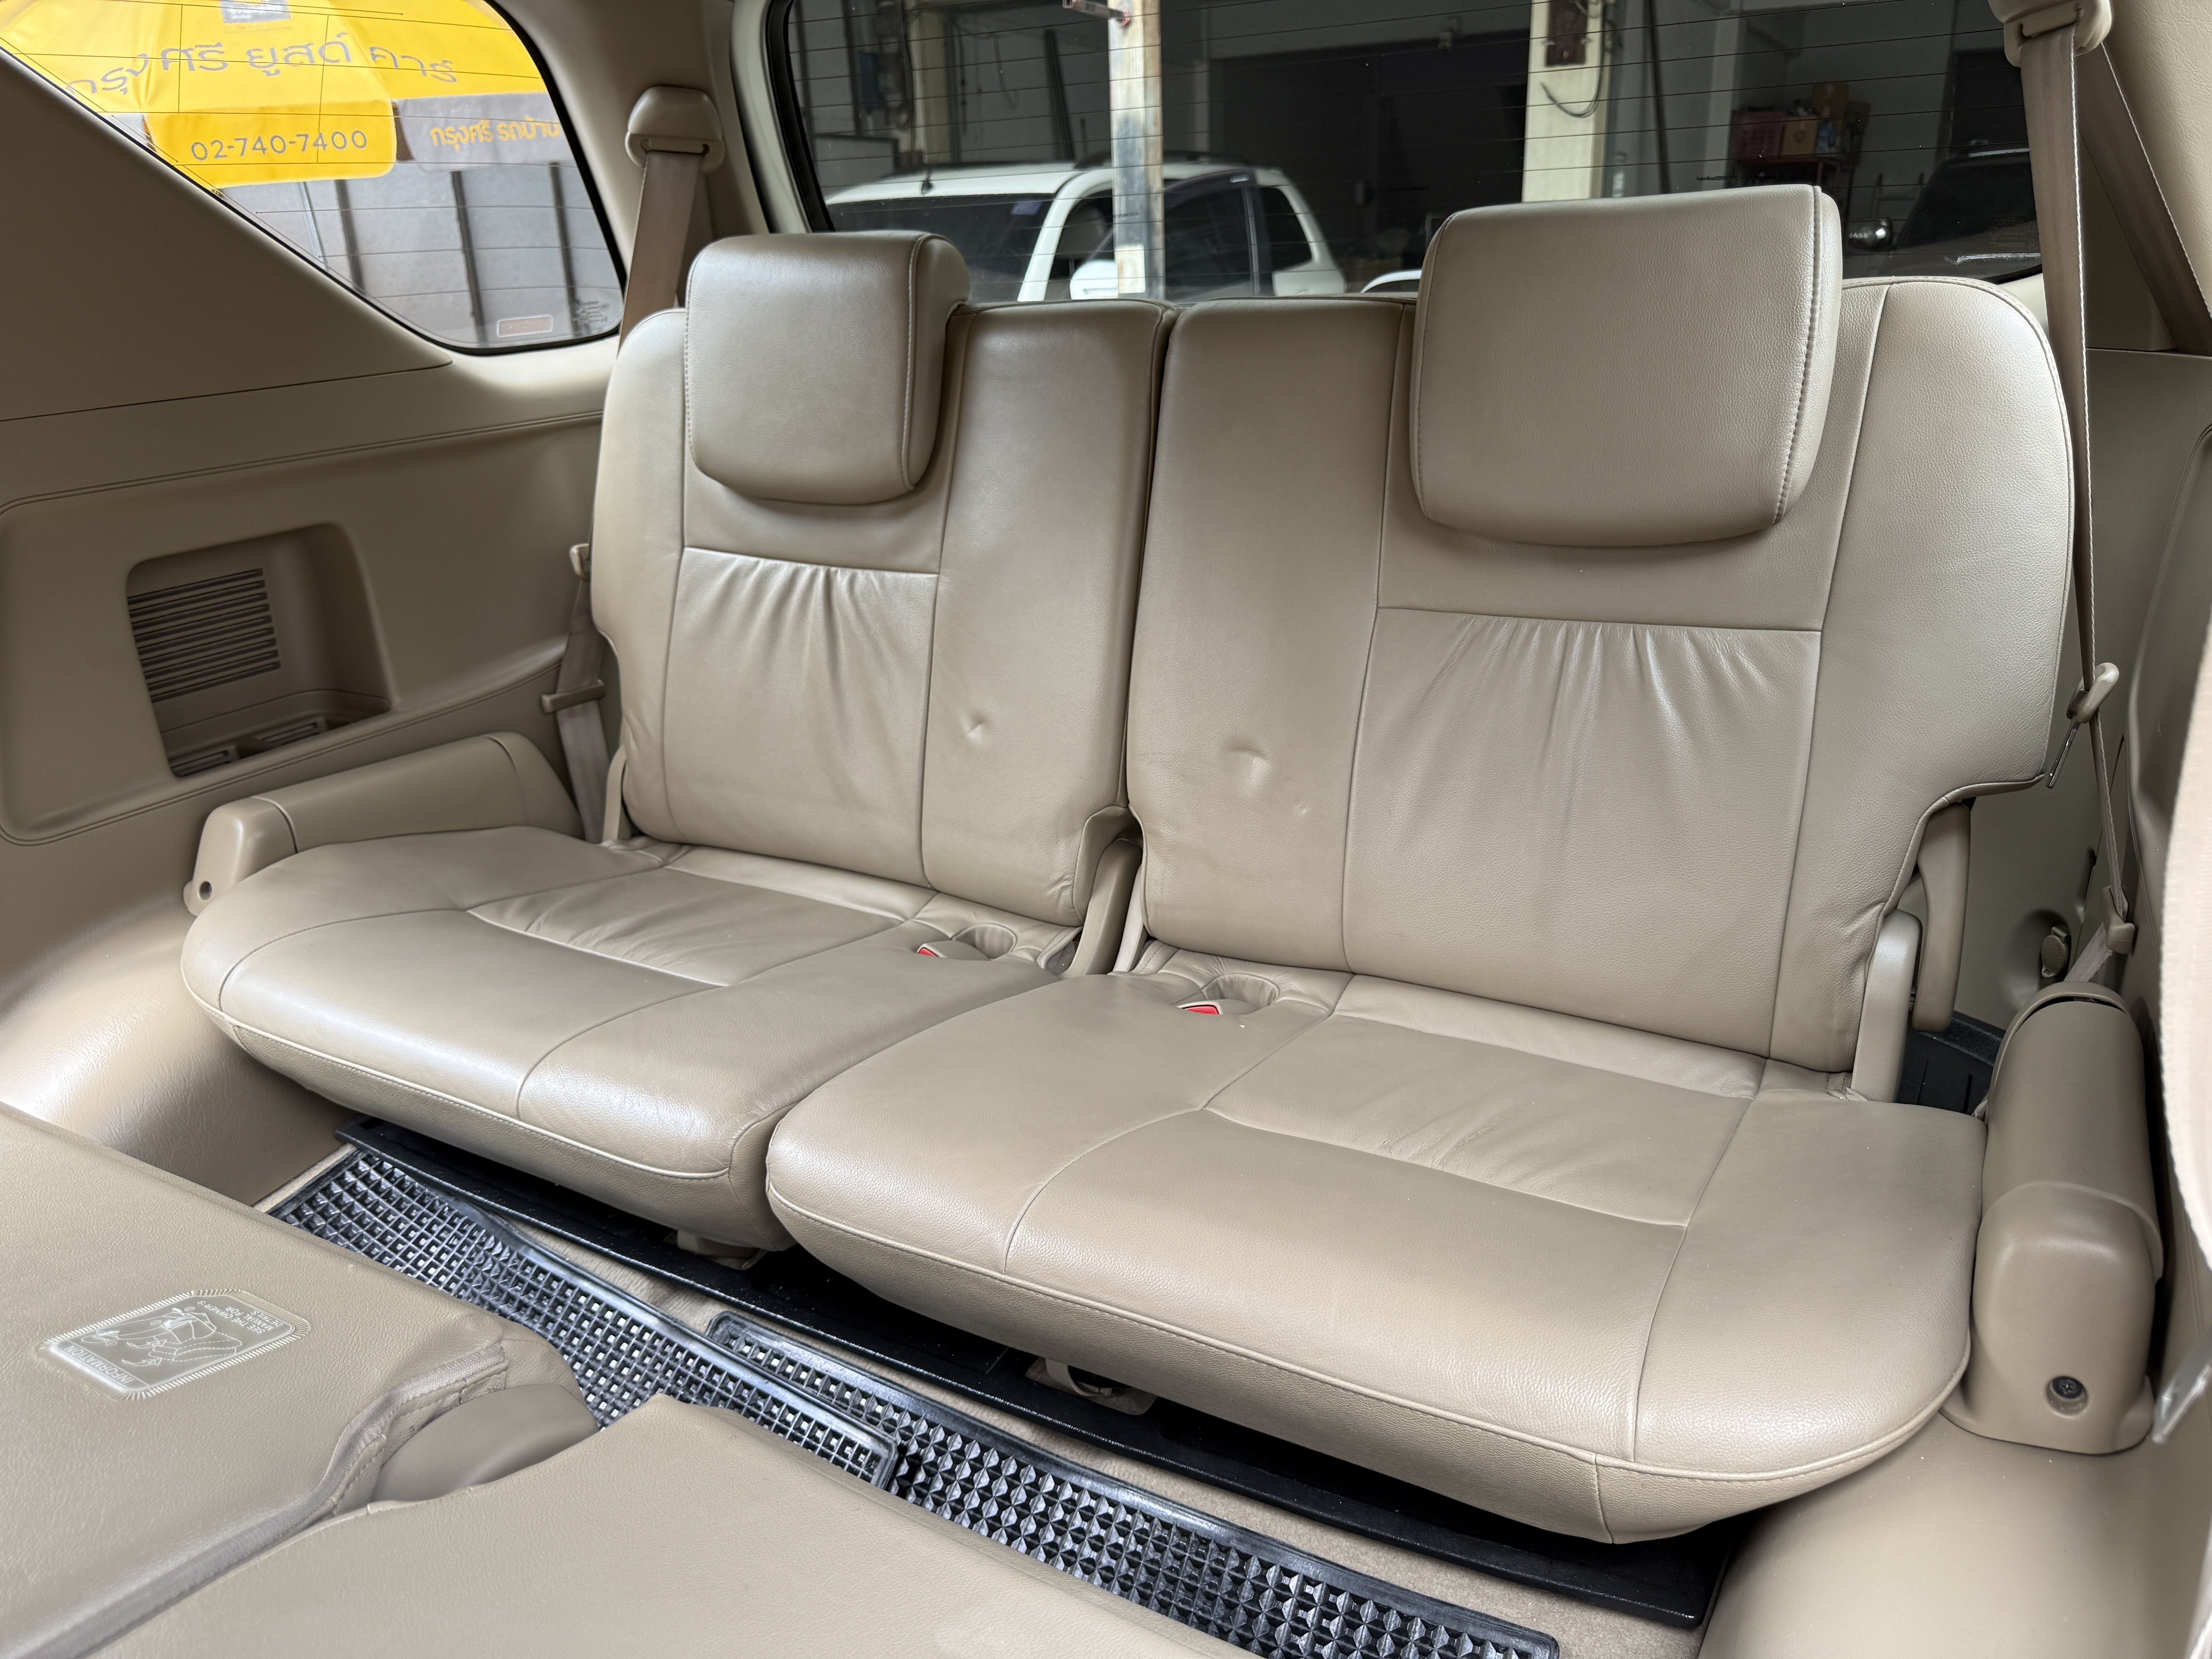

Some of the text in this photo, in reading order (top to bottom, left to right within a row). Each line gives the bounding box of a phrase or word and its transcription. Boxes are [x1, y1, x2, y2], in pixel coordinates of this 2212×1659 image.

[191, 130, 367, 161] 02-740-7400
[225, 1306, 275, 1331] MANUAL FOR
[231, 1317, 249, 1327] THE
[247, 1324, 265, 1334] SEE
[64, 1345, 135, 1383] INFORMATION
